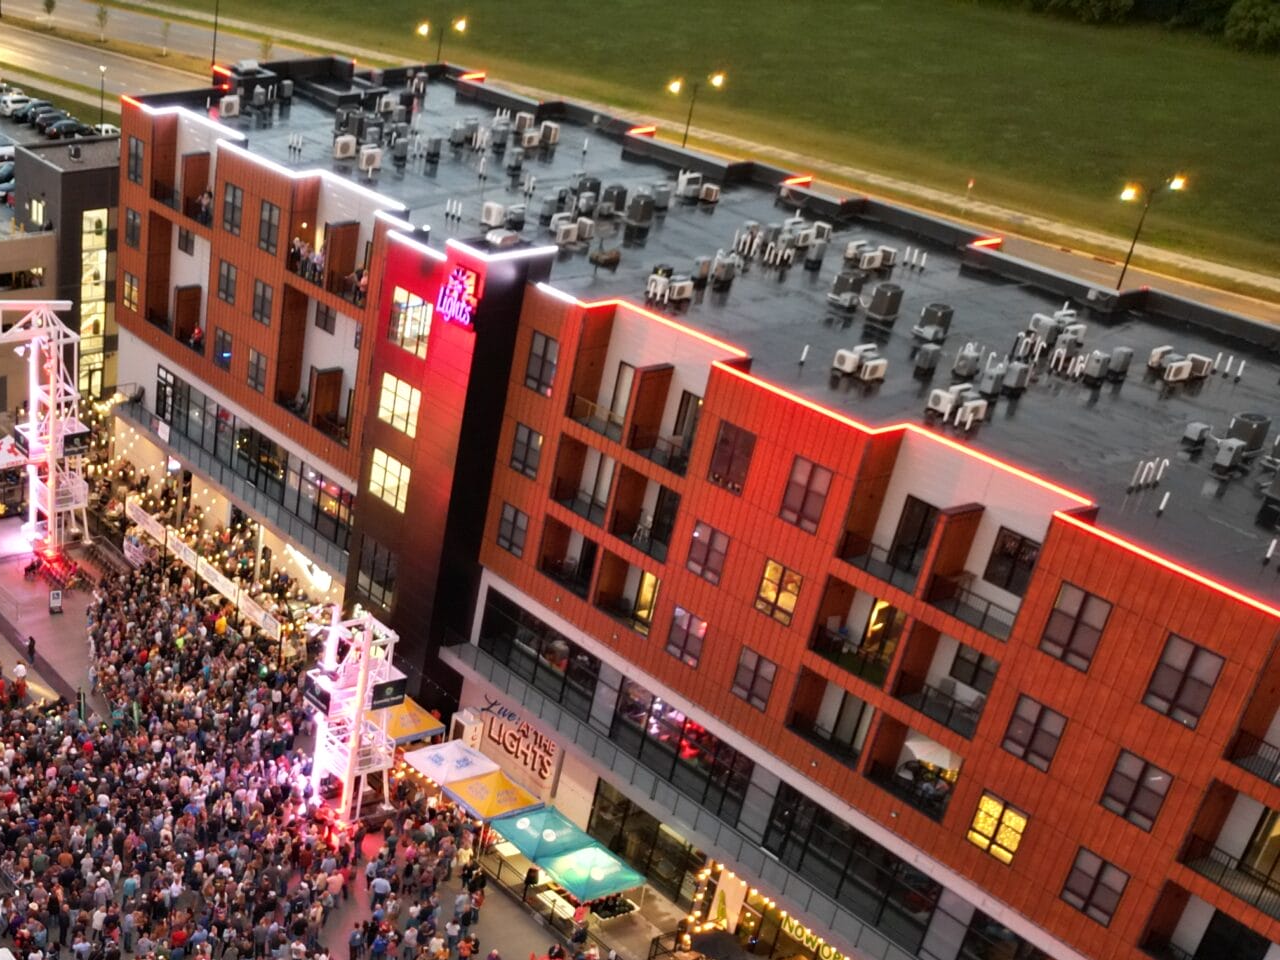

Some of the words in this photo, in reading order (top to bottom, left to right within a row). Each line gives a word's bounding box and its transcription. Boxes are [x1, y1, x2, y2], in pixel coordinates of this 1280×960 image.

[436, 285, 472, 325] Lights
[488, 716, 552, 779] LIGHTS
[783, 915, 818, 951] NOW
